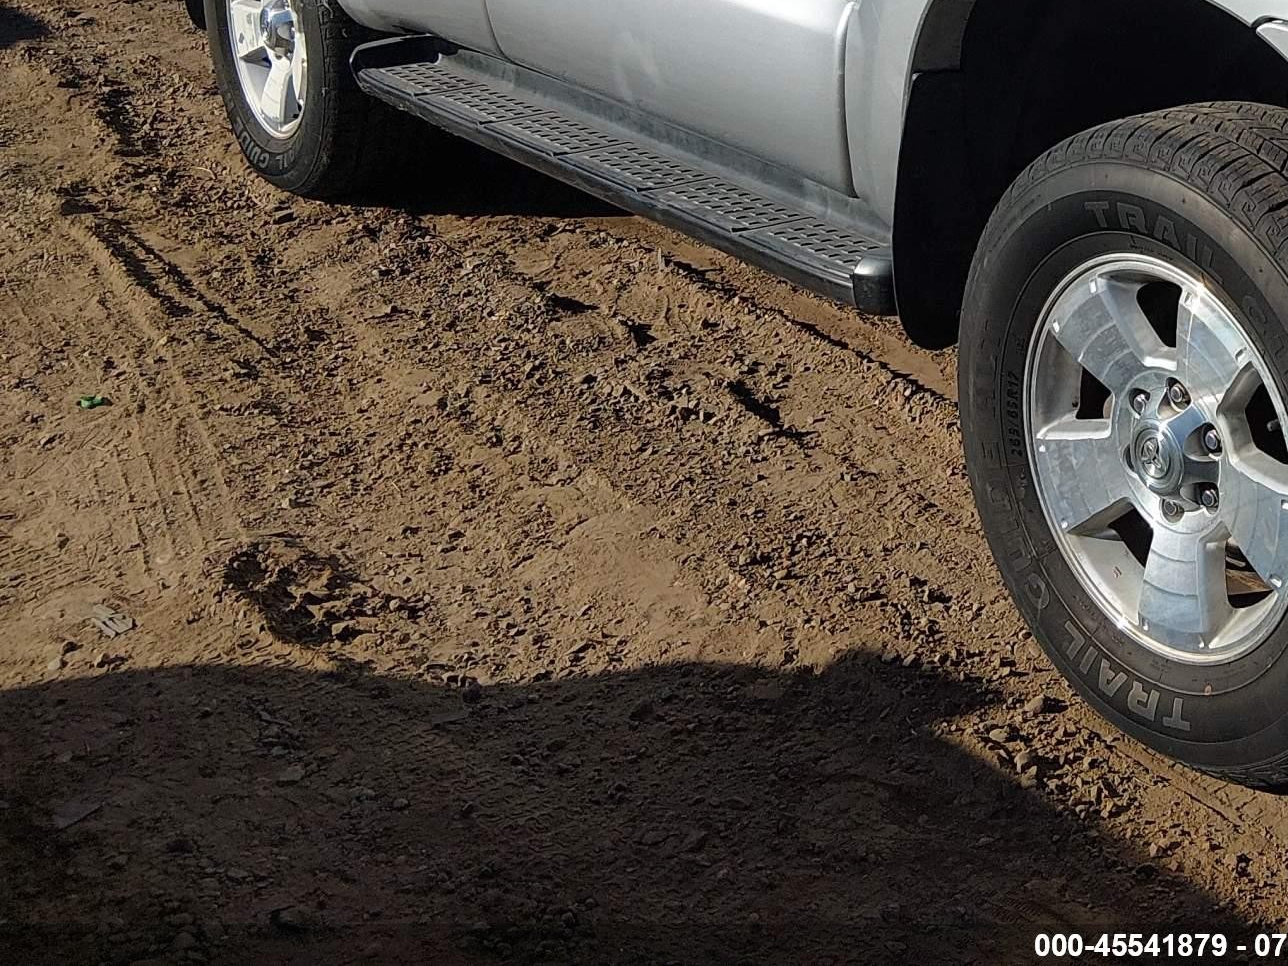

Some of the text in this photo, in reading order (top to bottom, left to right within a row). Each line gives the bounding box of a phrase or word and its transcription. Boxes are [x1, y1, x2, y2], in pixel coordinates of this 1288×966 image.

[1084, 201, 1224, 286] TRAIL
[1007, 371, 1023, 457] 265/65R17
[1064, 620, 1191, 732] TRAIL
